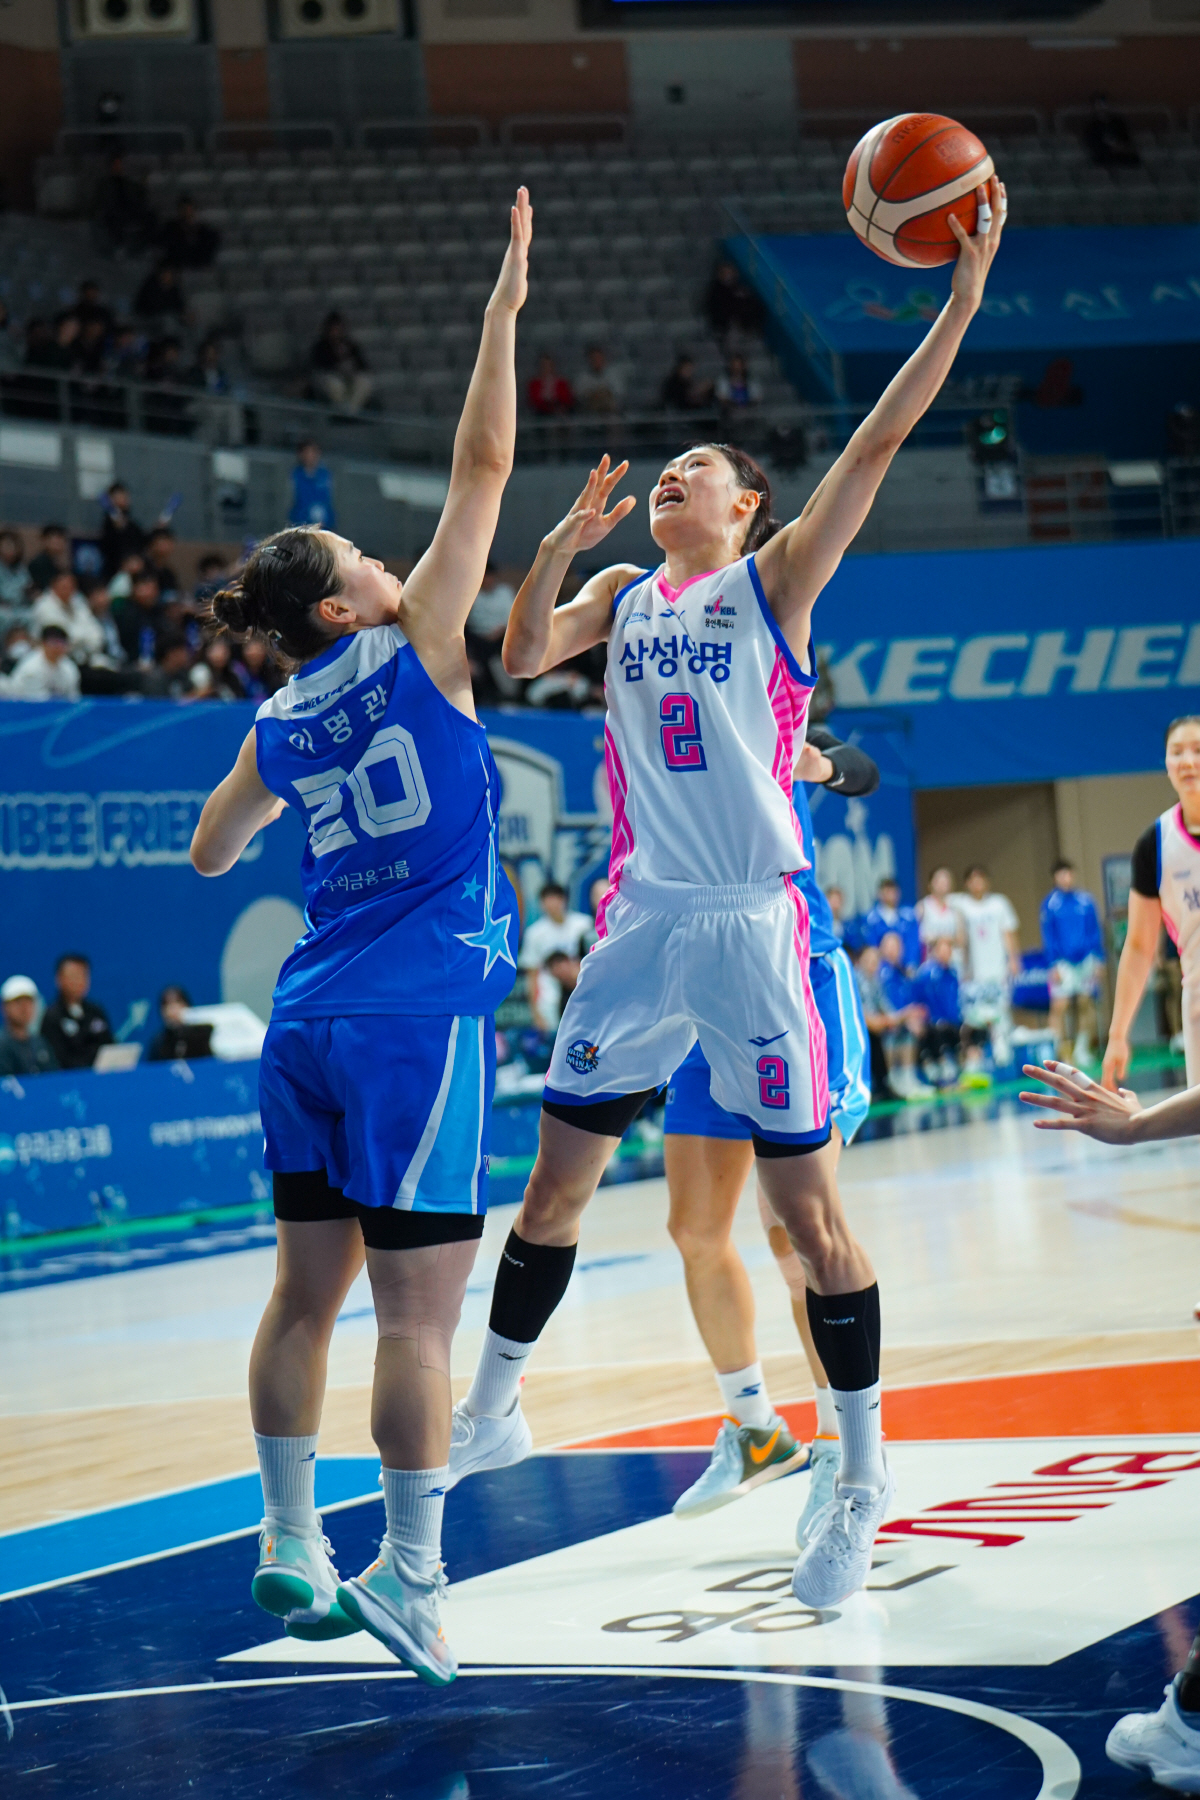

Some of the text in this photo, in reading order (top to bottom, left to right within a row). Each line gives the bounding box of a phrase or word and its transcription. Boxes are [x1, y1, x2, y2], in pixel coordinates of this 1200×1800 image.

[892, 115, 934, 144] molte
[619, 634, 732, 683] 삼성생명
[819, 624, 1200, 707] KECHE
[660, 692, 707, 772] 2
[290, 723, 432, 859] 20
[322, 860, 410, 892] 우리금융그룹
[568, 1047, 585, 1060] BLUE
[756, 1055, 790, 1110] 2
